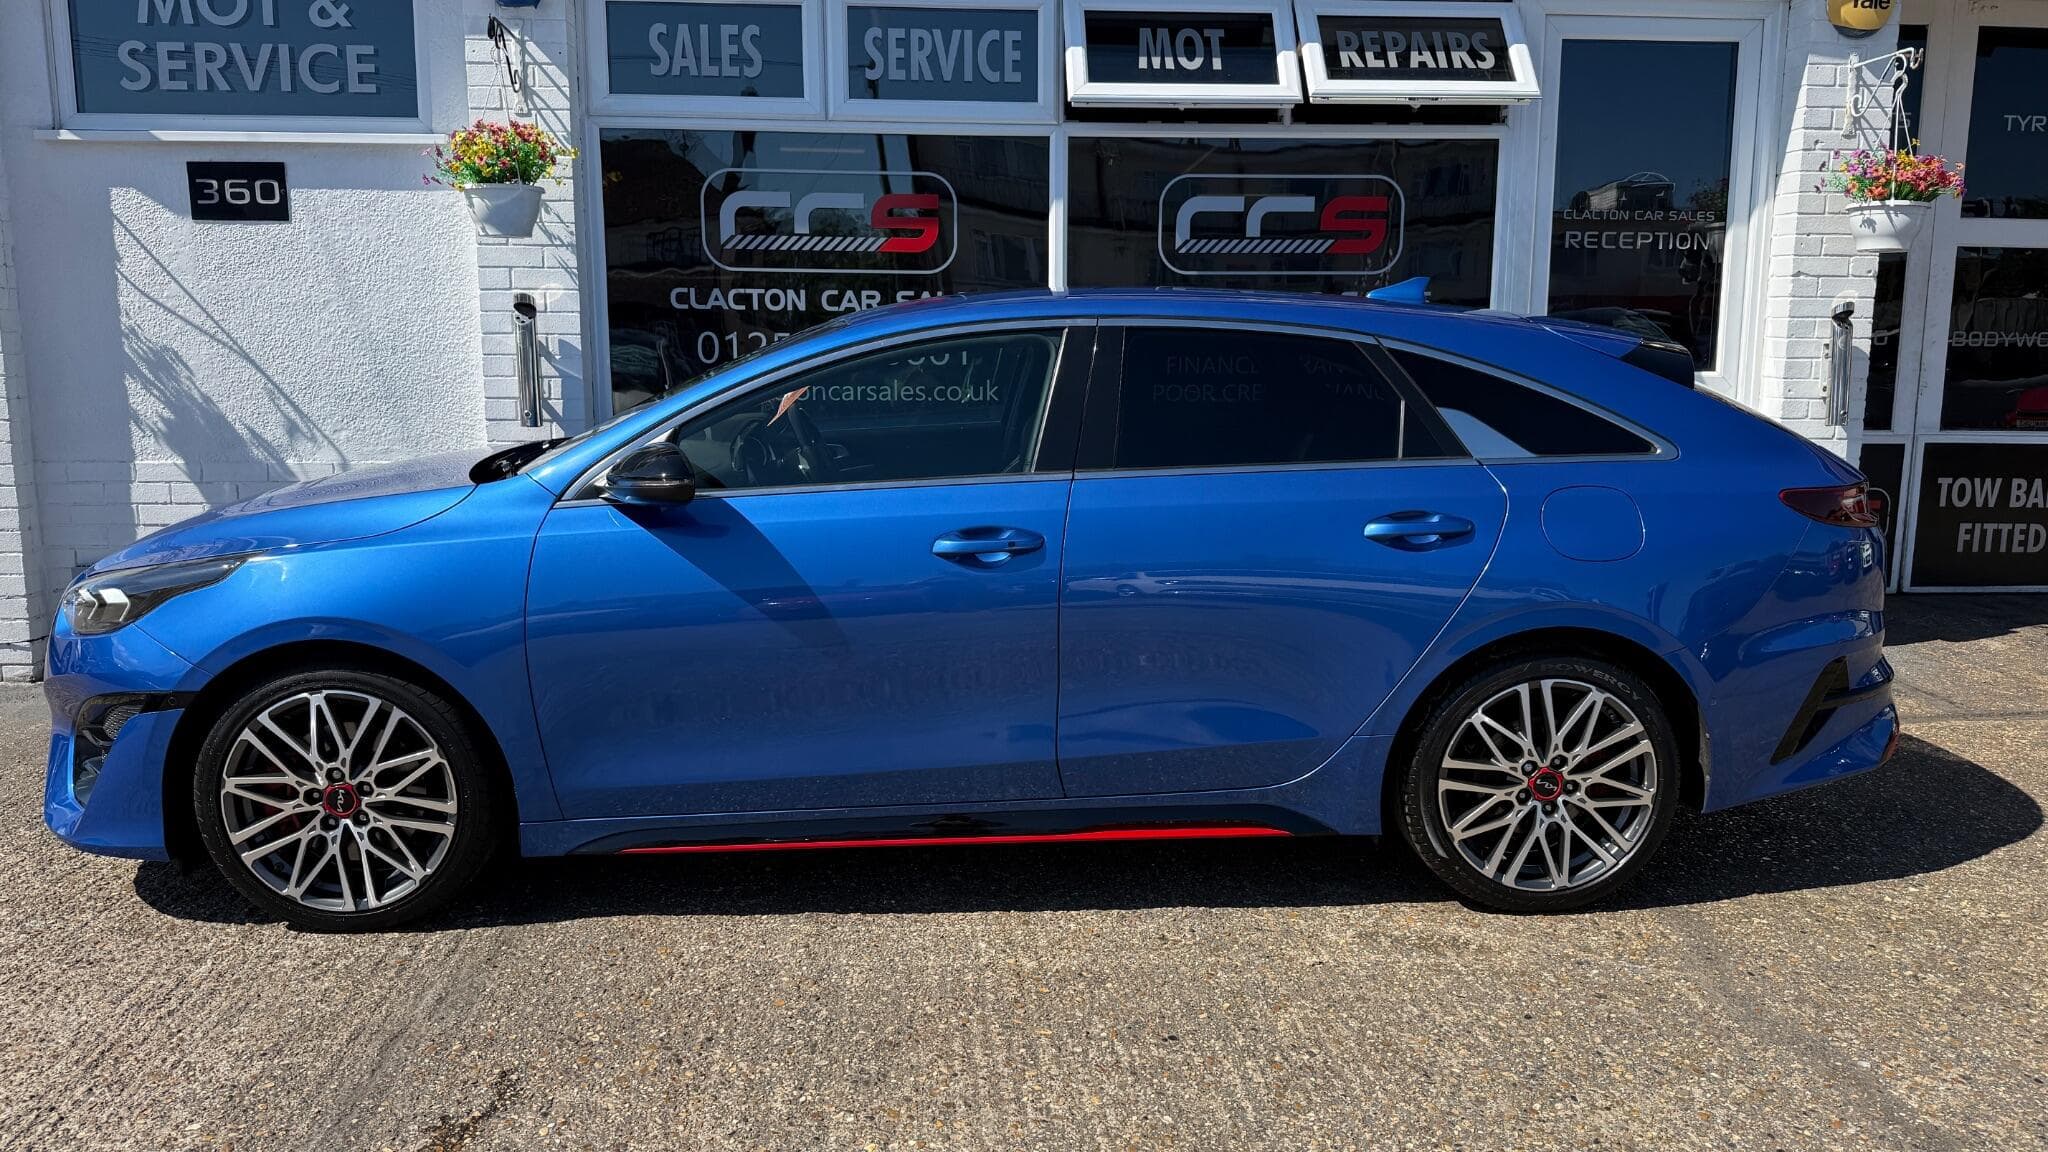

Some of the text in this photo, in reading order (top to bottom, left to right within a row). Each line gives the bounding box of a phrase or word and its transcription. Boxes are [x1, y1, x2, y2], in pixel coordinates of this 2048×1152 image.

[308, 0, 352, 28] &
[648, 22, 763, 78] SALES
[864, 26, 1023, 83] SERVICE
[1138, 28, 1225, 71] MOT
[1335, 30, 1496, 70] REPAIRS
[117, 40, 378, 94] SERVICE
[2004, 115, 2047, 132] TYR
[195, 178, 281, 205] 360
[1563, 209, 1715, 222] CLACTON CAR SALES
[1565, 231, 1710, 251] RECEPTION
[670, 287, 806, 311] CLACTON
[821, 290, 881, 311] CAR
[1937, 477, 2048, 508] TOW BA
[1956, 522, 2047, 553] FITTED
